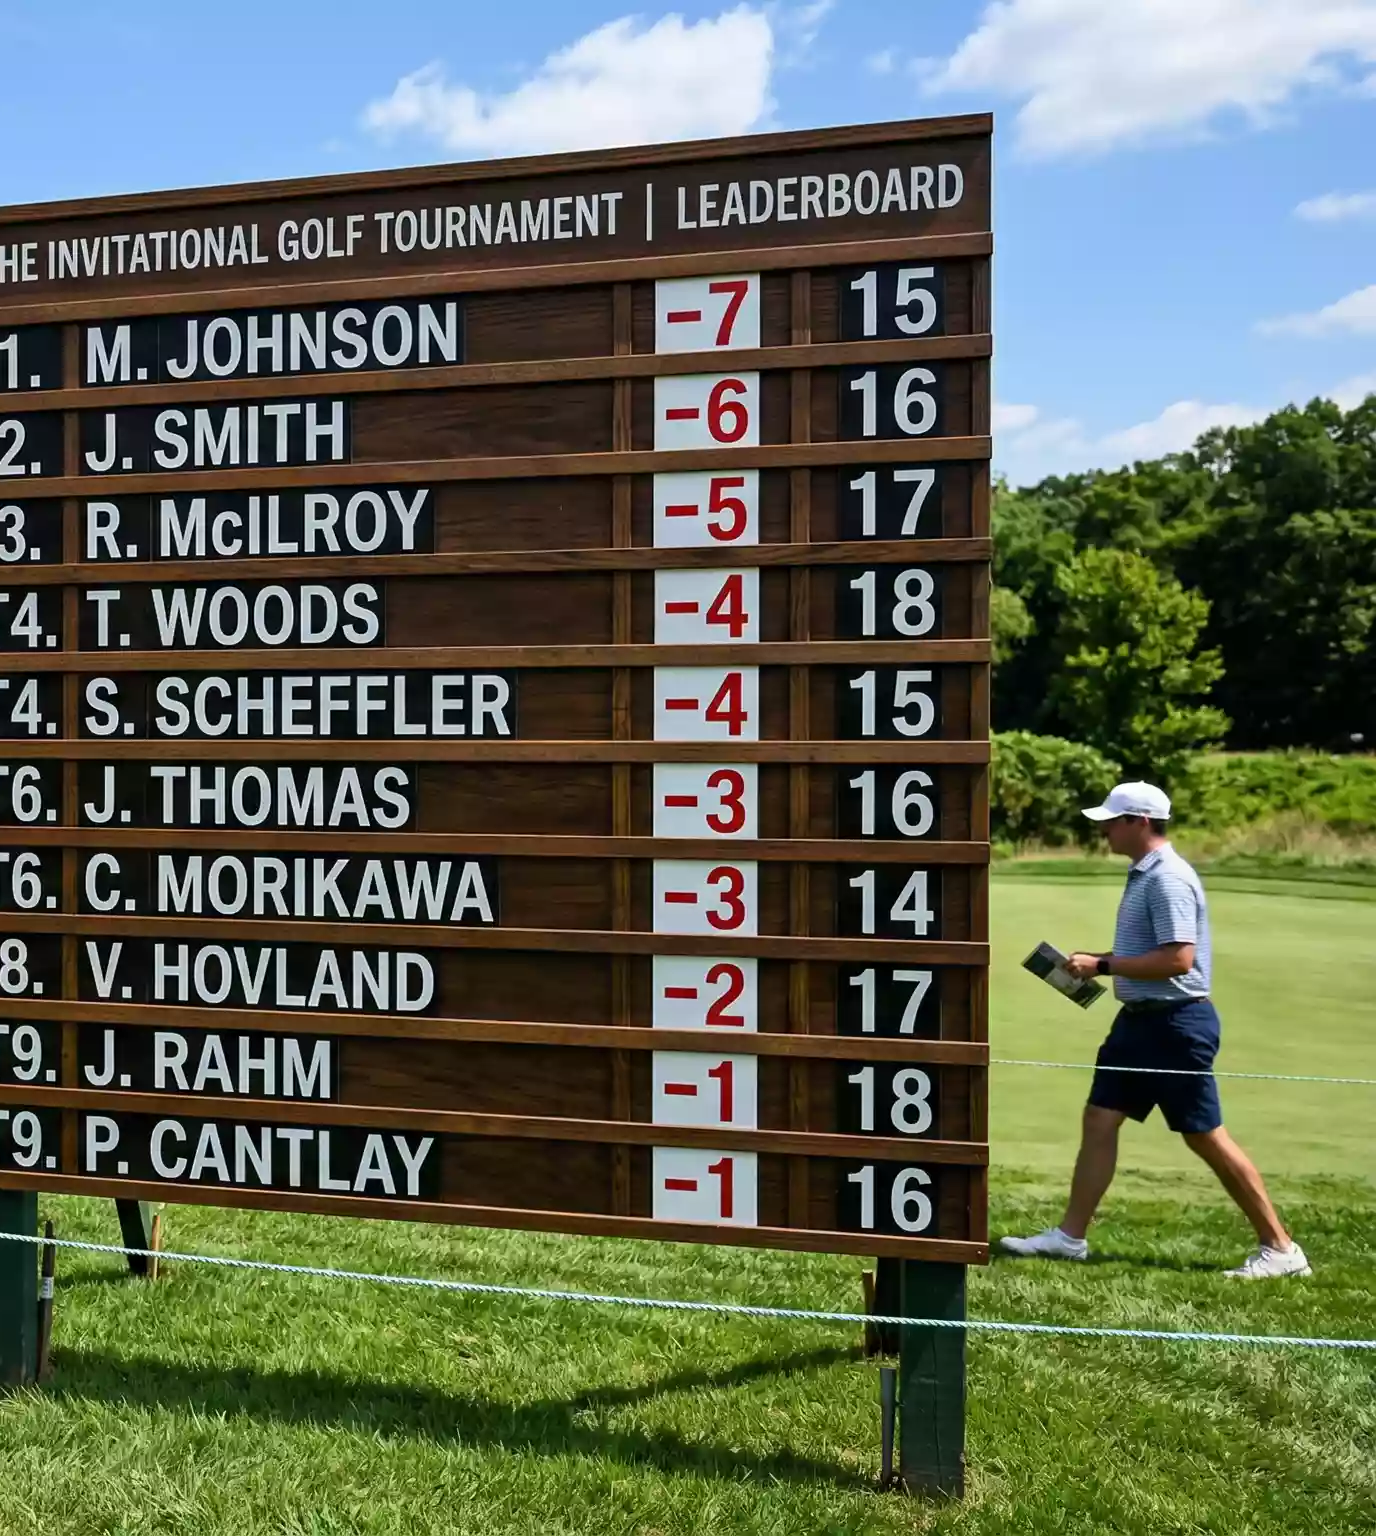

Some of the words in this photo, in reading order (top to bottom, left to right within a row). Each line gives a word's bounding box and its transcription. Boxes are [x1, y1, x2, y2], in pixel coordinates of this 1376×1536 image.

[47, 222, 270, 281] INVITATIONAL
[276, 210, 366, 263] GOLF
[373, 190, 624, 255] TOURNAMENT
[676, 162, 965, 231] LEADERBOARD
[85, 318, 149, 385] M.
[165, 301, 458, 380] JOHNSON
[668, 280, 748, 347] -7
[849, 265, 938, 338] 15
[83, 412, 134, 473] J.
[152, 400, 345, 470] SMITH
[666, 378, 749, 444] -6
[849, 366, 938, 438] 16
[85, 501, 139, 560] R.
[159, 488, 430, 558] McILROY
[665, 477, 748, 542] -5
[848, 467, 937, 537] 17
[85, 588, 132, 648] T.
[150, 582, 380, 647] WOODS
[665, 573, 747, 638] -4
[849, 567, 937, 637] 18
[84, 676, 136, 737] S.
[154, 673, 512, 737] SCHEFFLER
[665, 671, 748, 736] -4
[848, 669, 936, 738] 15
[83, 764, 132, 825] J.
[149, 765, 411, 830] THOMAS
[664, 769, 747, 835] -3
[848, 769, 935, 838] 16
[84, 851, 137, 912] C.
[156, 854, 495, 924] MORIKAWA
[665, 866, 745, 931] -3
[848, 868, 935, 937] 14
[84, 940, 134, 1000] V.
[153, 942, 435, 1013] HOVLAND
[666, 964, 744, 1027] -2
[848, 967, 934, 1035] 17
[83, 1028, 133, 1088] J.
[153, 1030, 332, 1100] RAHM
[665, 1061, 733, 1122] -1
[847, 1065, 933, 1135] 18
[85, 1114, 130, 1176] P.
[149, 1118, 435, 1197] CANTLAY
[665, 1158, 732, 1218] -1
[846, 1164, 933, 1233] 16
